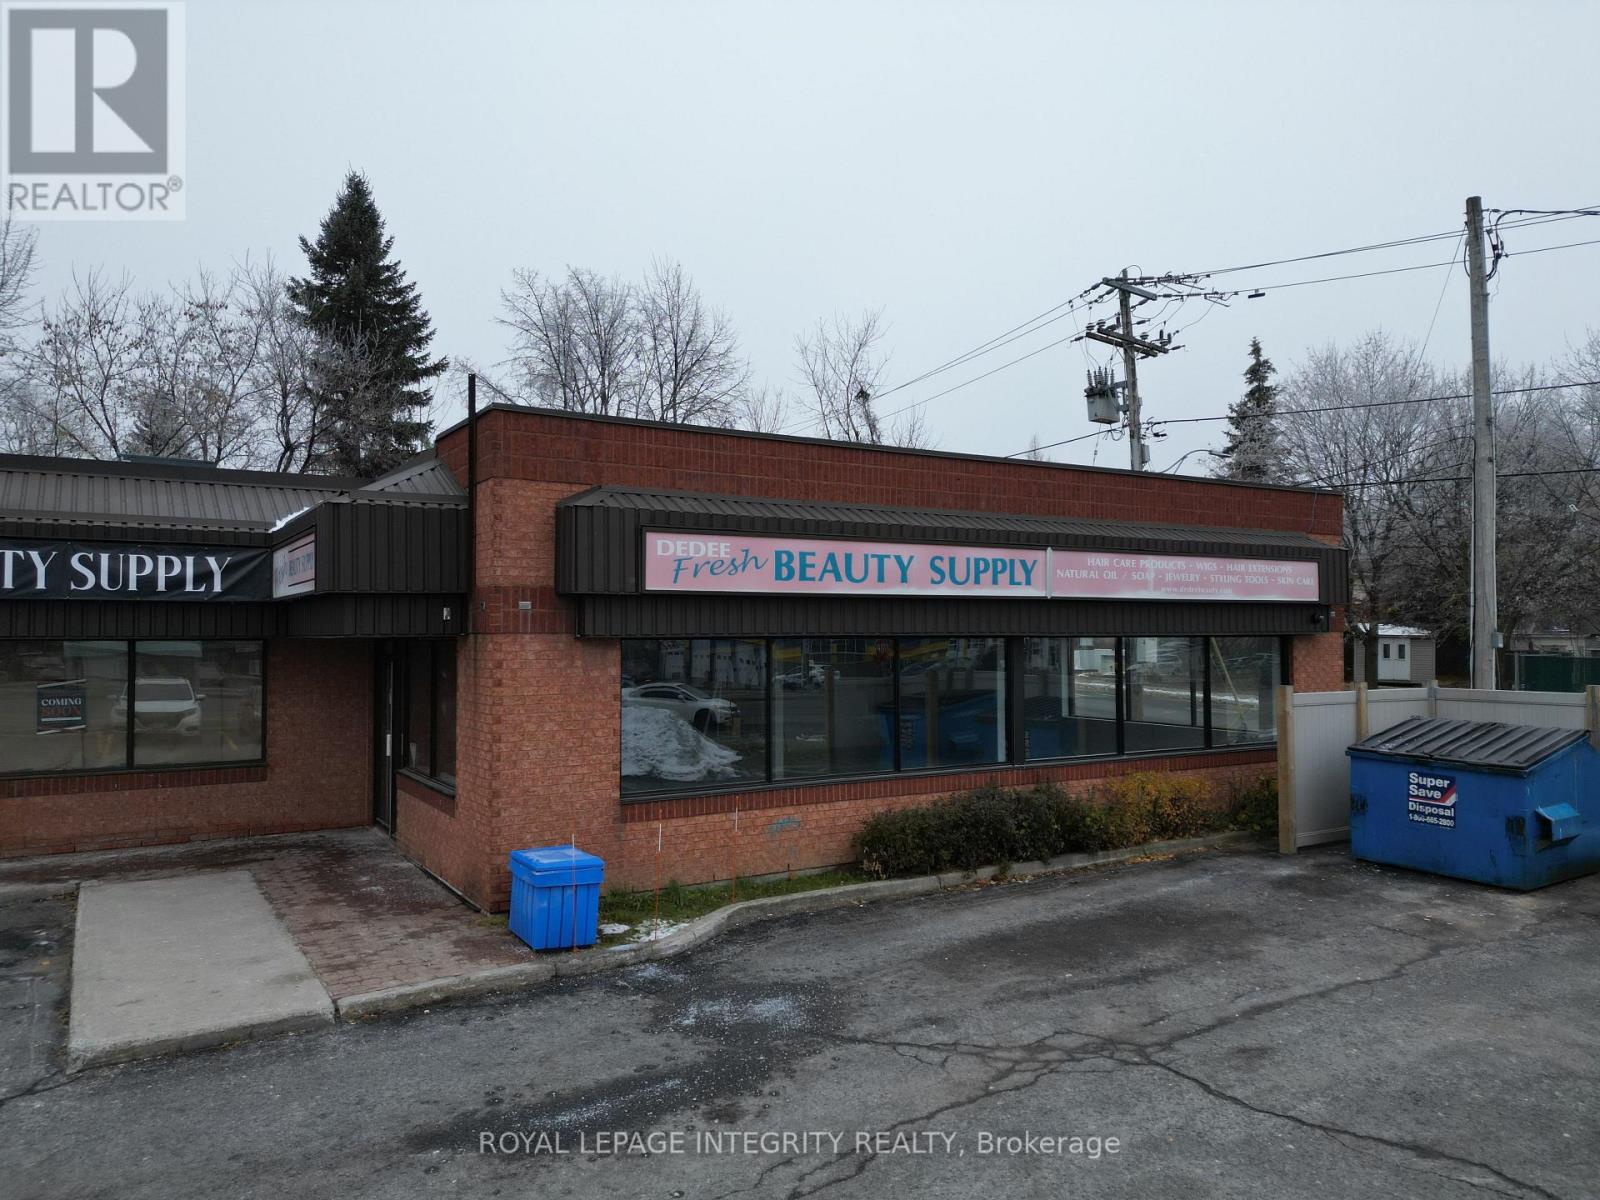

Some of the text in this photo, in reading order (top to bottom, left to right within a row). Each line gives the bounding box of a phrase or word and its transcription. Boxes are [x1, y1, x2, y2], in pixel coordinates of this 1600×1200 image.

[656, 539, 731, 558] DEDEE
[70, 551, 232, 593] SUPPLY
[672, 548, 769, 584] Fresh
[774, 549, 1038, 586] BEAUTY SUPPLY
[1087, 557, 1110, 567] HAIR
[1113, 558, 1137, 568] CARE
[1140, 559, 1187, 571] PRODUCTS
[1197, 561, 1217, 571] WIGS
[1226, 563, 1247, 573] HAIR
[1247, 564, 1294, 575] EXTENSIONS
[1056, 568, 1100, 579] NATURAL
[1103, 569, 1119, 580] OIL
[1131, 570, 1155, 581] SOAP
[1165, 572, 1201, 583] JEWELRY
[1209, 574, 1242, 585] STYLING
[1245, 575, 1269, 585] TOOLS
[1277, 576, 1295, 586] SKIN
[41, 697, 82, 707] COMING
[1409, 772, 1450, 788] Super
[1409, 784, 1442, 799] Save
[1408, 801, 1454, 817] Disposal
